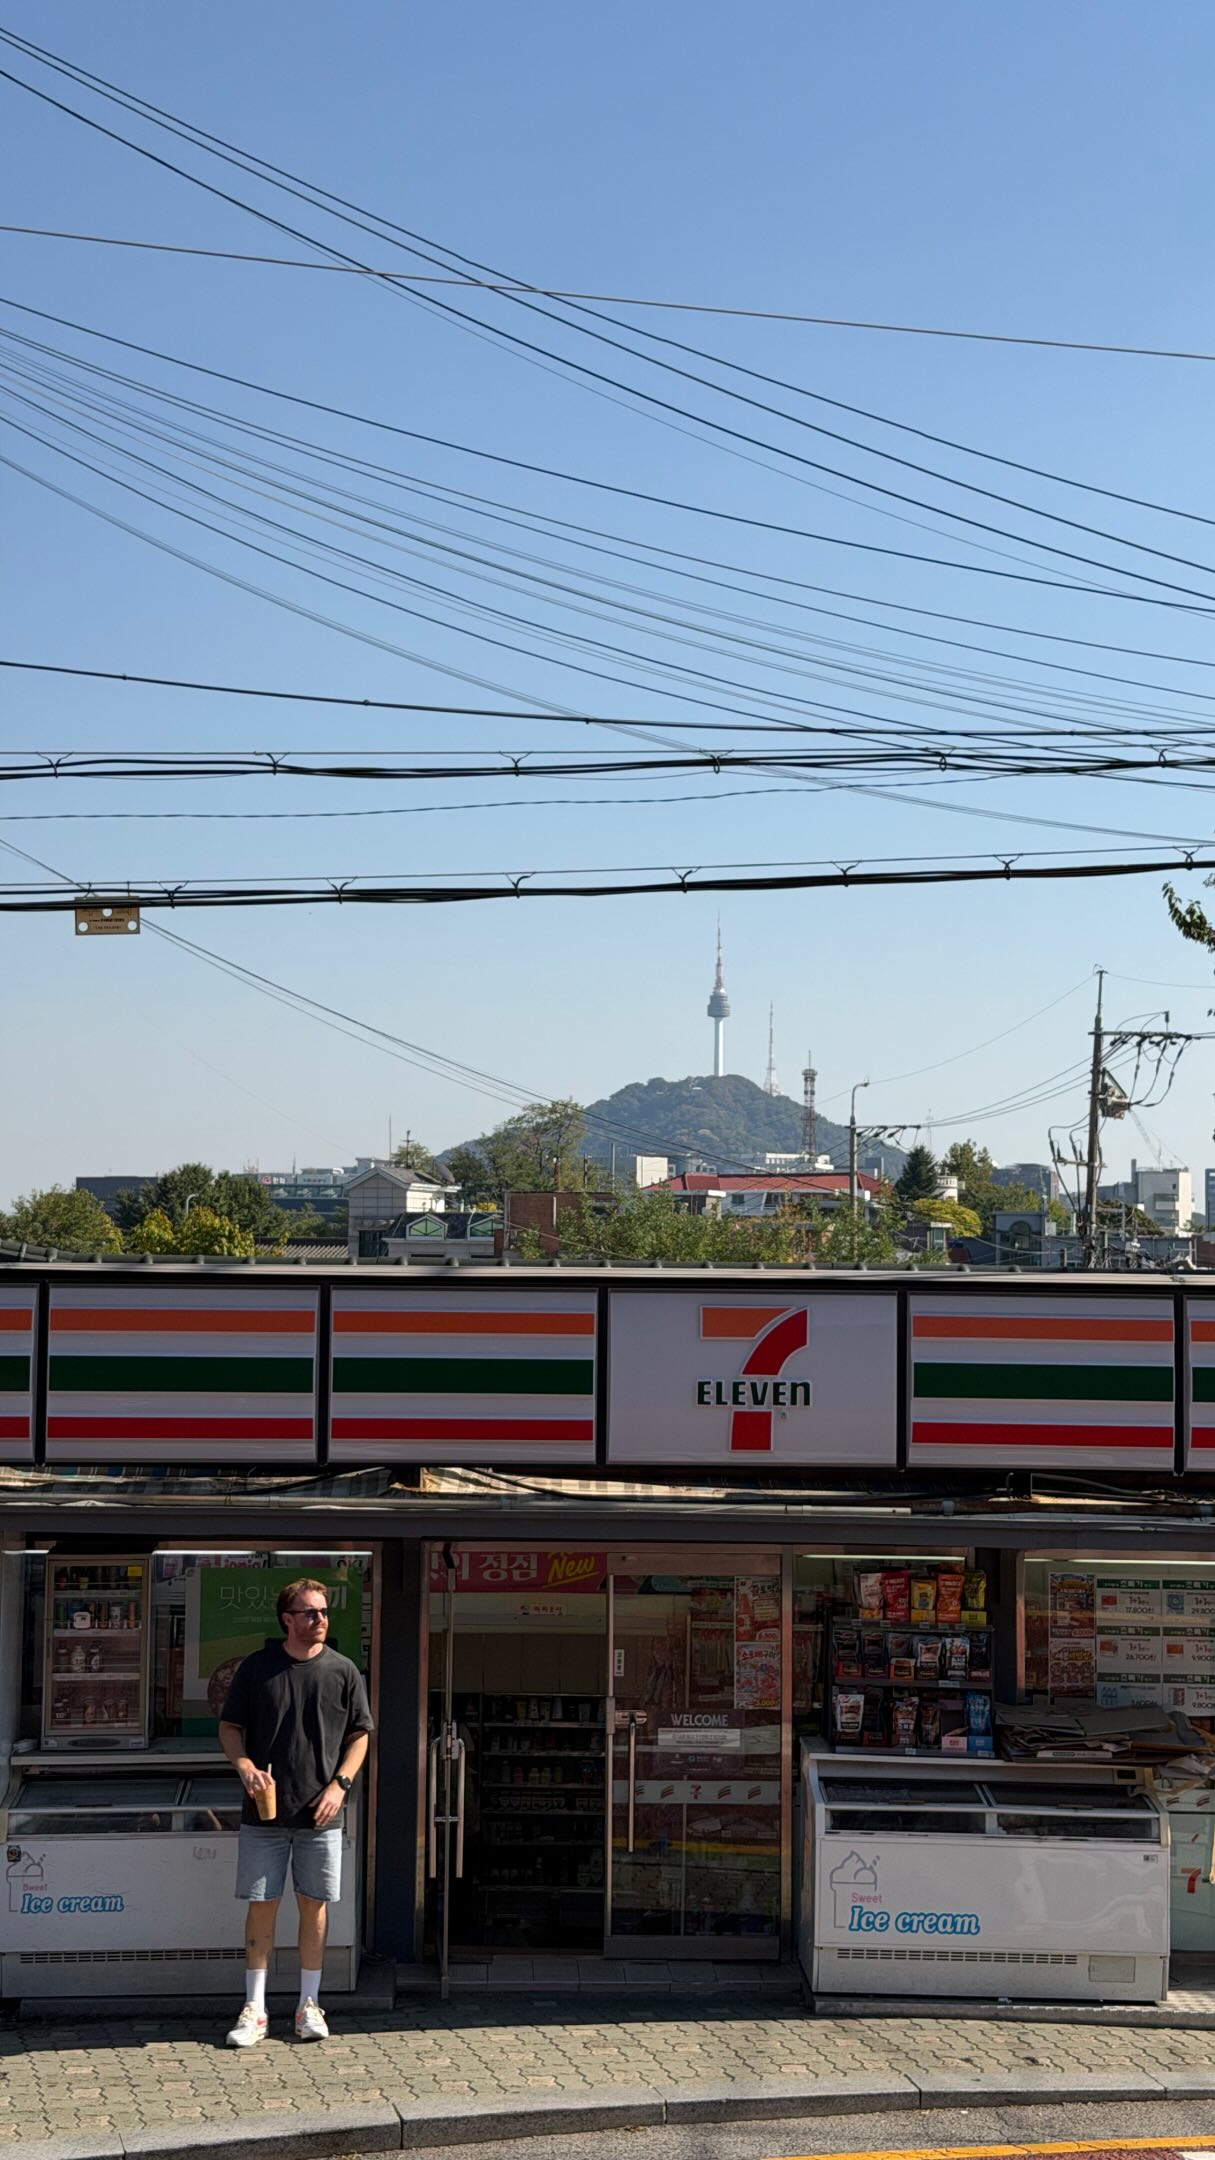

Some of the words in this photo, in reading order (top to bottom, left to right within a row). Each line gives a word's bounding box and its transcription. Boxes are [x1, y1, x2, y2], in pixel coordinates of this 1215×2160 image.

[702, 1306, 808, 1451] 7
[480, 1552, 538, 1582] 정점
[547, 1554, 596, 1581] New
[670, 1713, 729, 1727] WELCOME
[21, 1893, 54, 1914] Ice
[57, 1895, 125, 1914] cream
[851, 1892, 882, 1903] Sweet
[848, 1905, 891, 1932] Ice
[895, 1911, 980, 1935] cream
